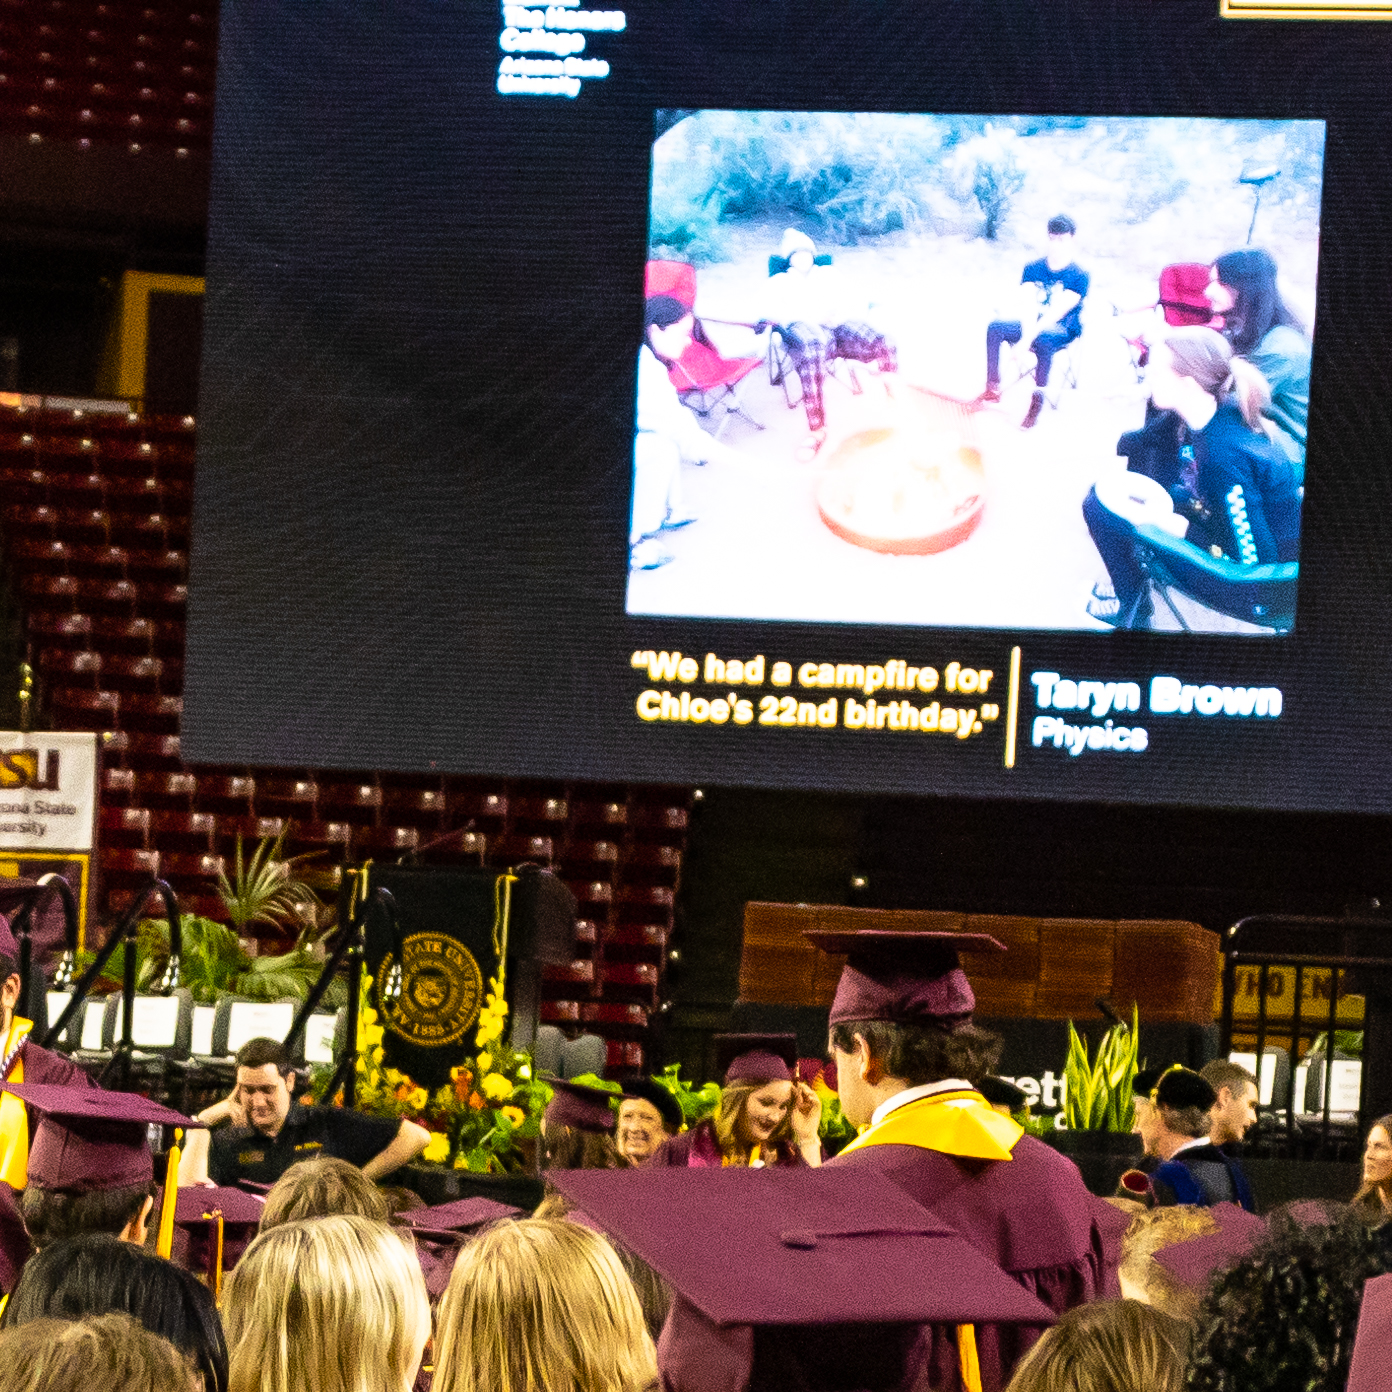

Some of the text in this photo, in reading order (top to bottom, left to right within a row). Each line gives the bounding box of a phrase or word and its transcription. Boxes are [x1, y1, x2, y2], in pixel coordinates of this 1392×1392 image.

[704, 653, 765, 685] had
[770, 661, 792, 687] a
[798, 659, 939, 696] campfire
[944, 662, 993, 693] for
[1030, 671, 1283, 717] Taryn Brown
[758, 695, 838, 728] 22nd
[1032, 715, 1149, 757] Physics
[34, 800, 77, 816] State
